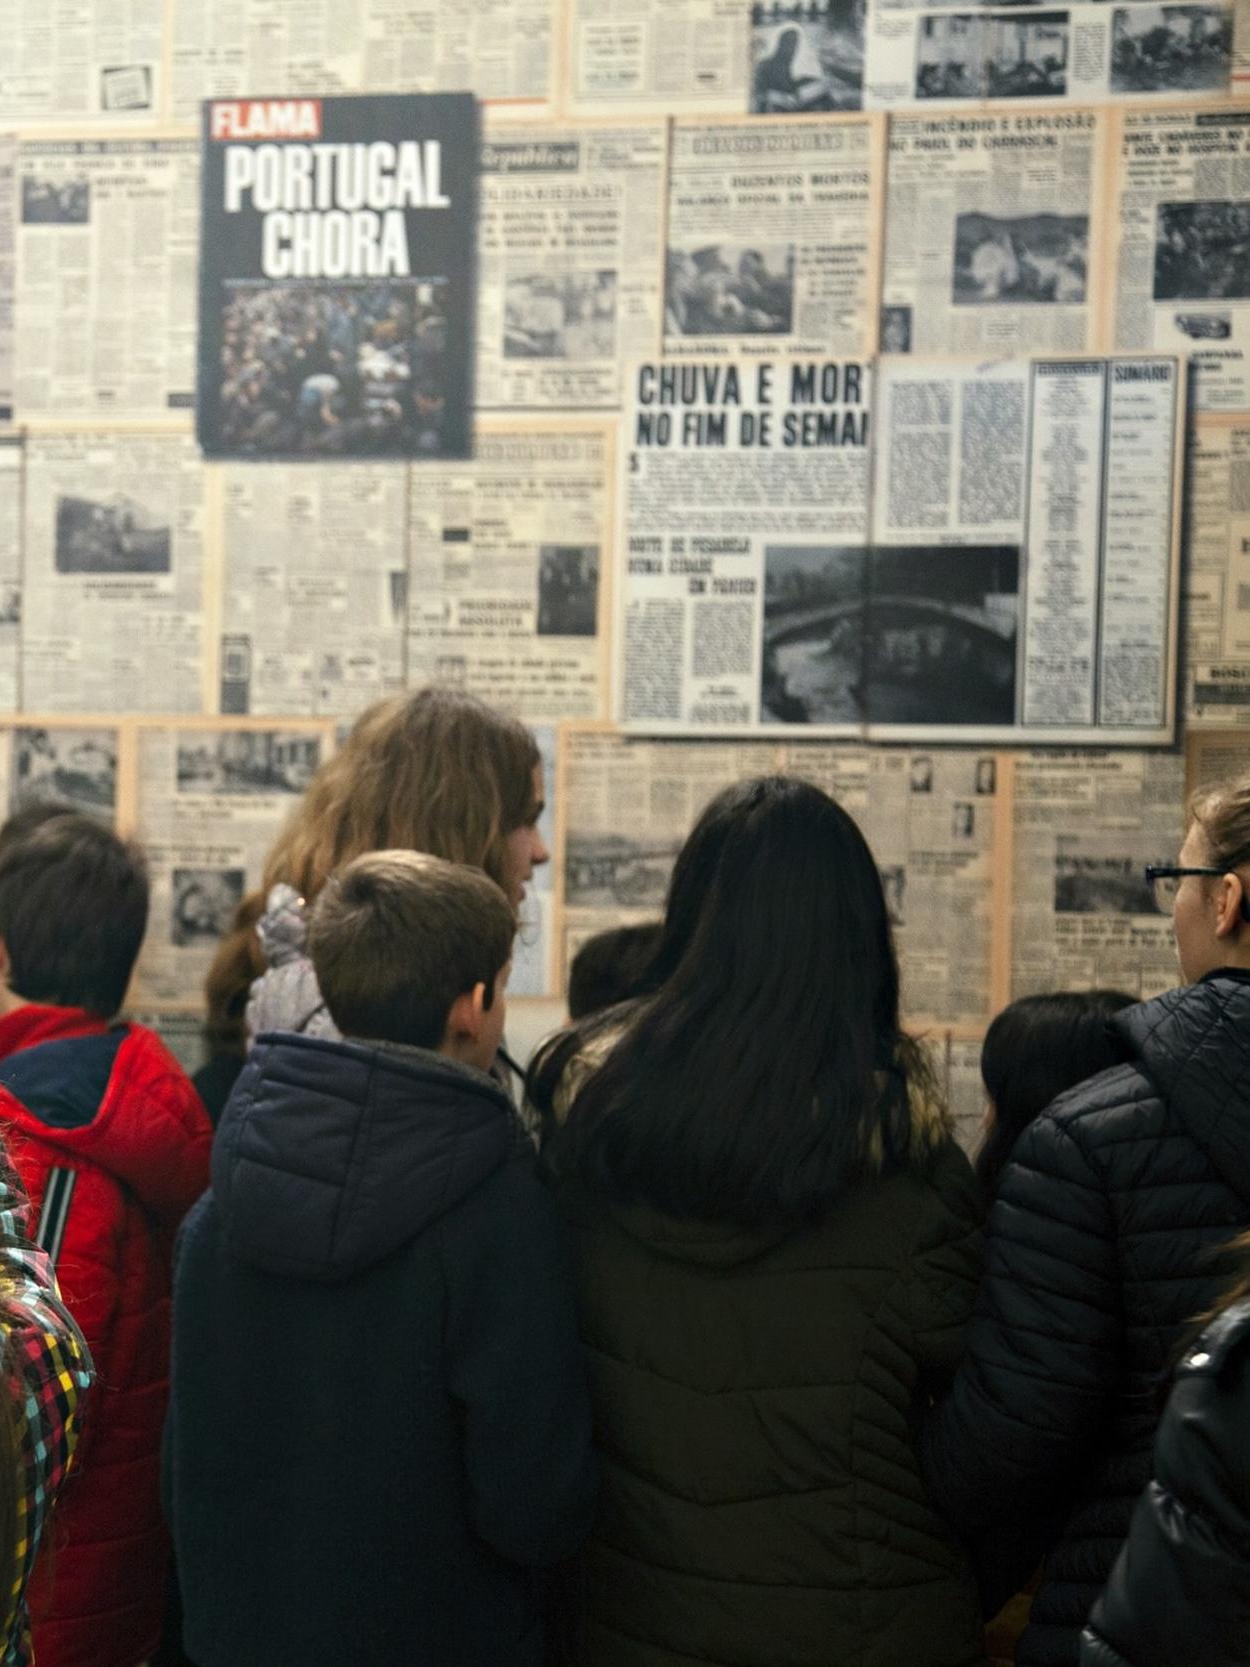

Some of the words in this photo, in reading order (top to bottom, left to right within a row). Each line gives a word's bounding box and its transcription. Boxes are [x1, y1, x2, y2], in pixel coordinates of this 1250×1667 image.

[212, 102, 319, 137] FLAMA
[224, 140, 452, 213] PORTUGAL
[262, 209, 411, 279] CHORA
[638, 364, 741, 405] CHUVA
[757, 364, 774, 404] E
[636, 412, 672, 447] NO
[682, 412, 727, 446] FIM
[739, 412, 773, 446] DE
